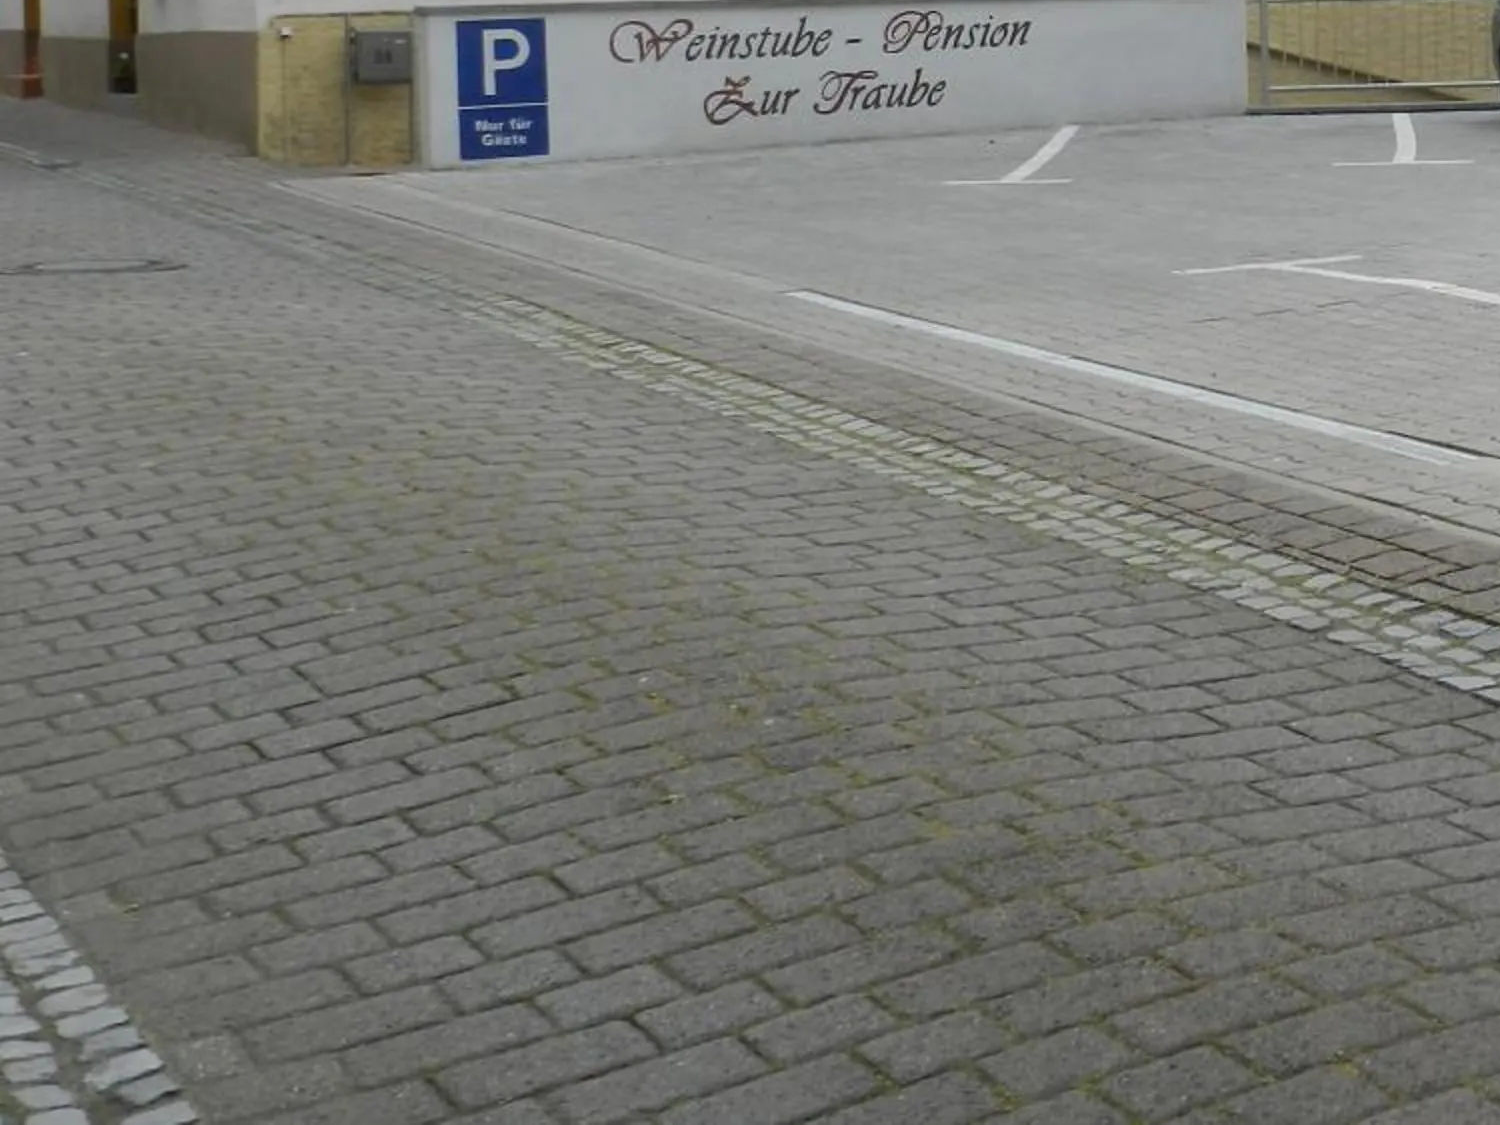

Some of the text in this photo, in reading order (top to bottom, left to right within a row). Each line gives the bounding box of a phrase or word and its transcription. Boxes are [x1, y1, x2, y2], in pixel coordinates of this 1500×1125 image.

[482, 28, 531, 96] P
[608, 16, 834, 64] Weinstube
[883, 10, 1032, 54] Pension
[703, 67, 947, 126] Zur Traube
[475, 117, 532, 131] Nur für
[482, 133, 527, 146] Gäste
